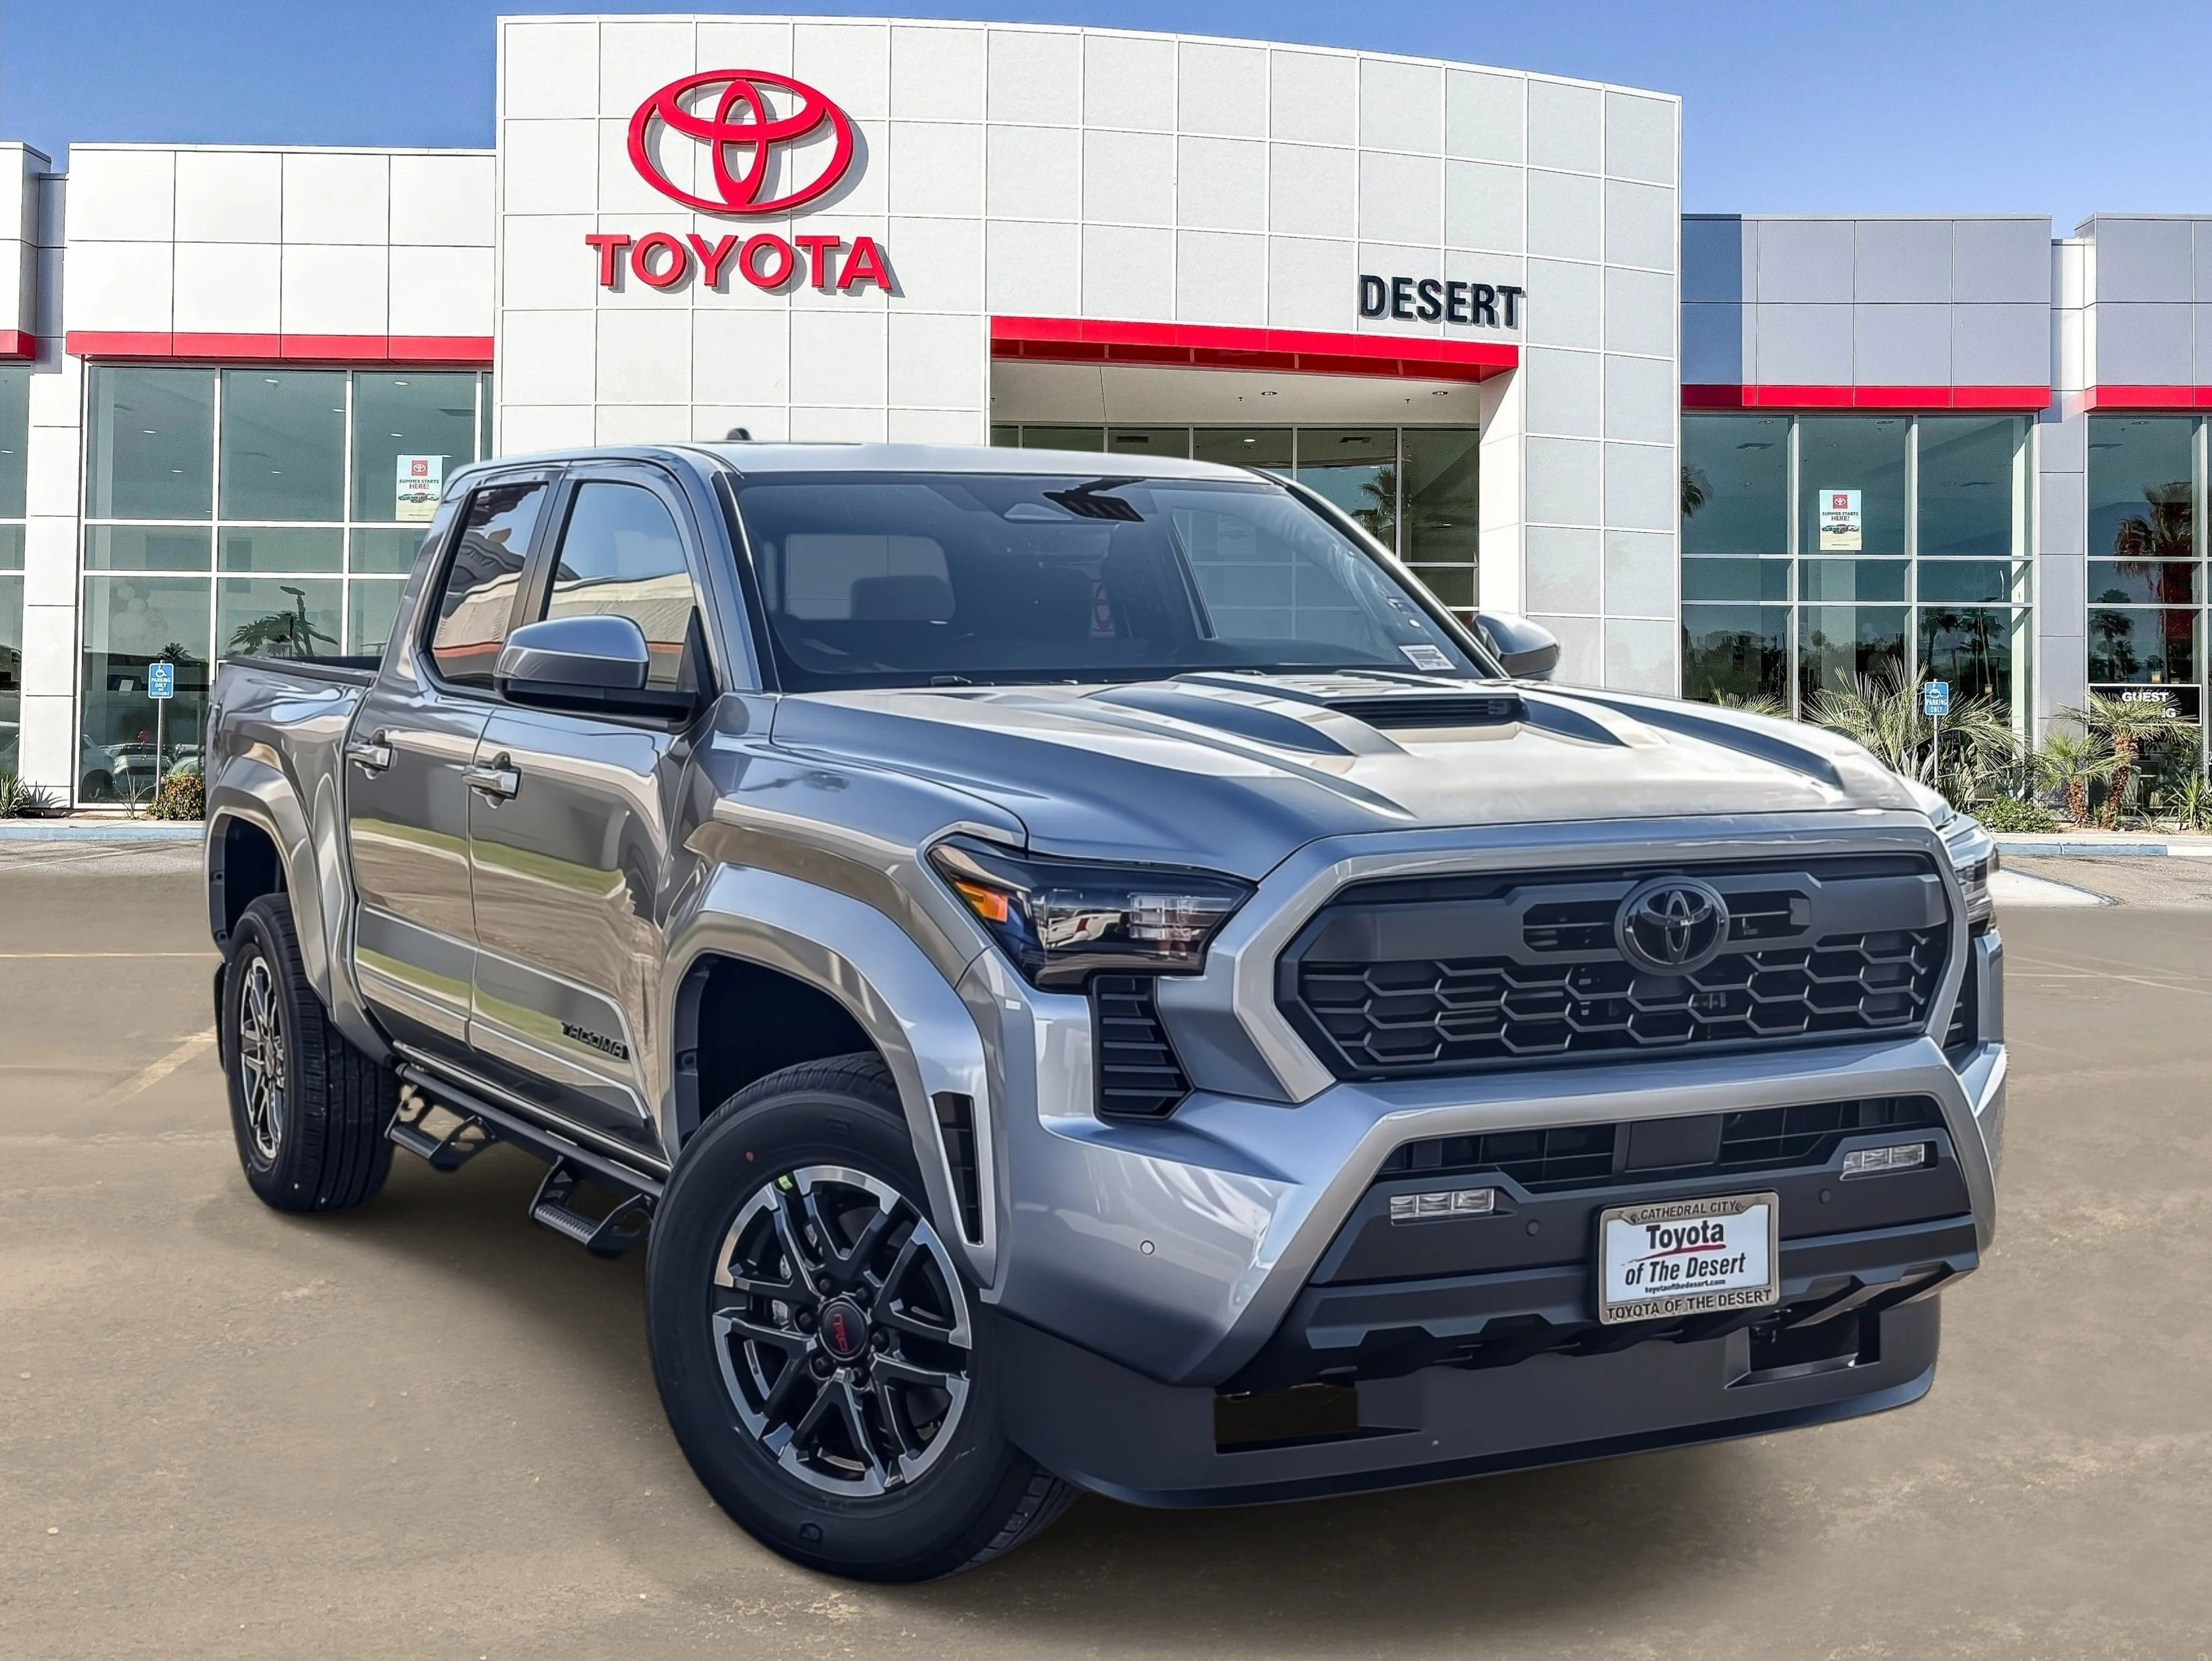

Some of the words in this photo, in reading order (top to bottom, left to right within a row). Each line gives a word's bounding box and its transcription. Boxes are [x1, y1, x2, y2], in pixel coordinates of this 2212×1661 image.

[585, 232, 893, 291] TOYOTA
[1359, 274, 1521, 326] DESERT
[2121, 692, 2170, 703] GUEST
[1641, 1203, 1706, 1221] CATHEDRAL
[1711, 1200, 1737, 1212] CITY
[1646, 1220, 1724, 1250] Toyota
[1625, 1263, 1646, 1285] of
[1650, 1261, 1678, 1282] The
[1686, 1253, 1746, 1278] Desert
[1645, 1278, 1726, 1295] toyotaofthedesert.com
[1606, 1303, 1659, 1319] TOYOTA
[1664, 1299, 1682, 1313] OF
[1687, 1295, 1714, 1309] THE
[1719, 1289, 1772, 1307] DESERT
